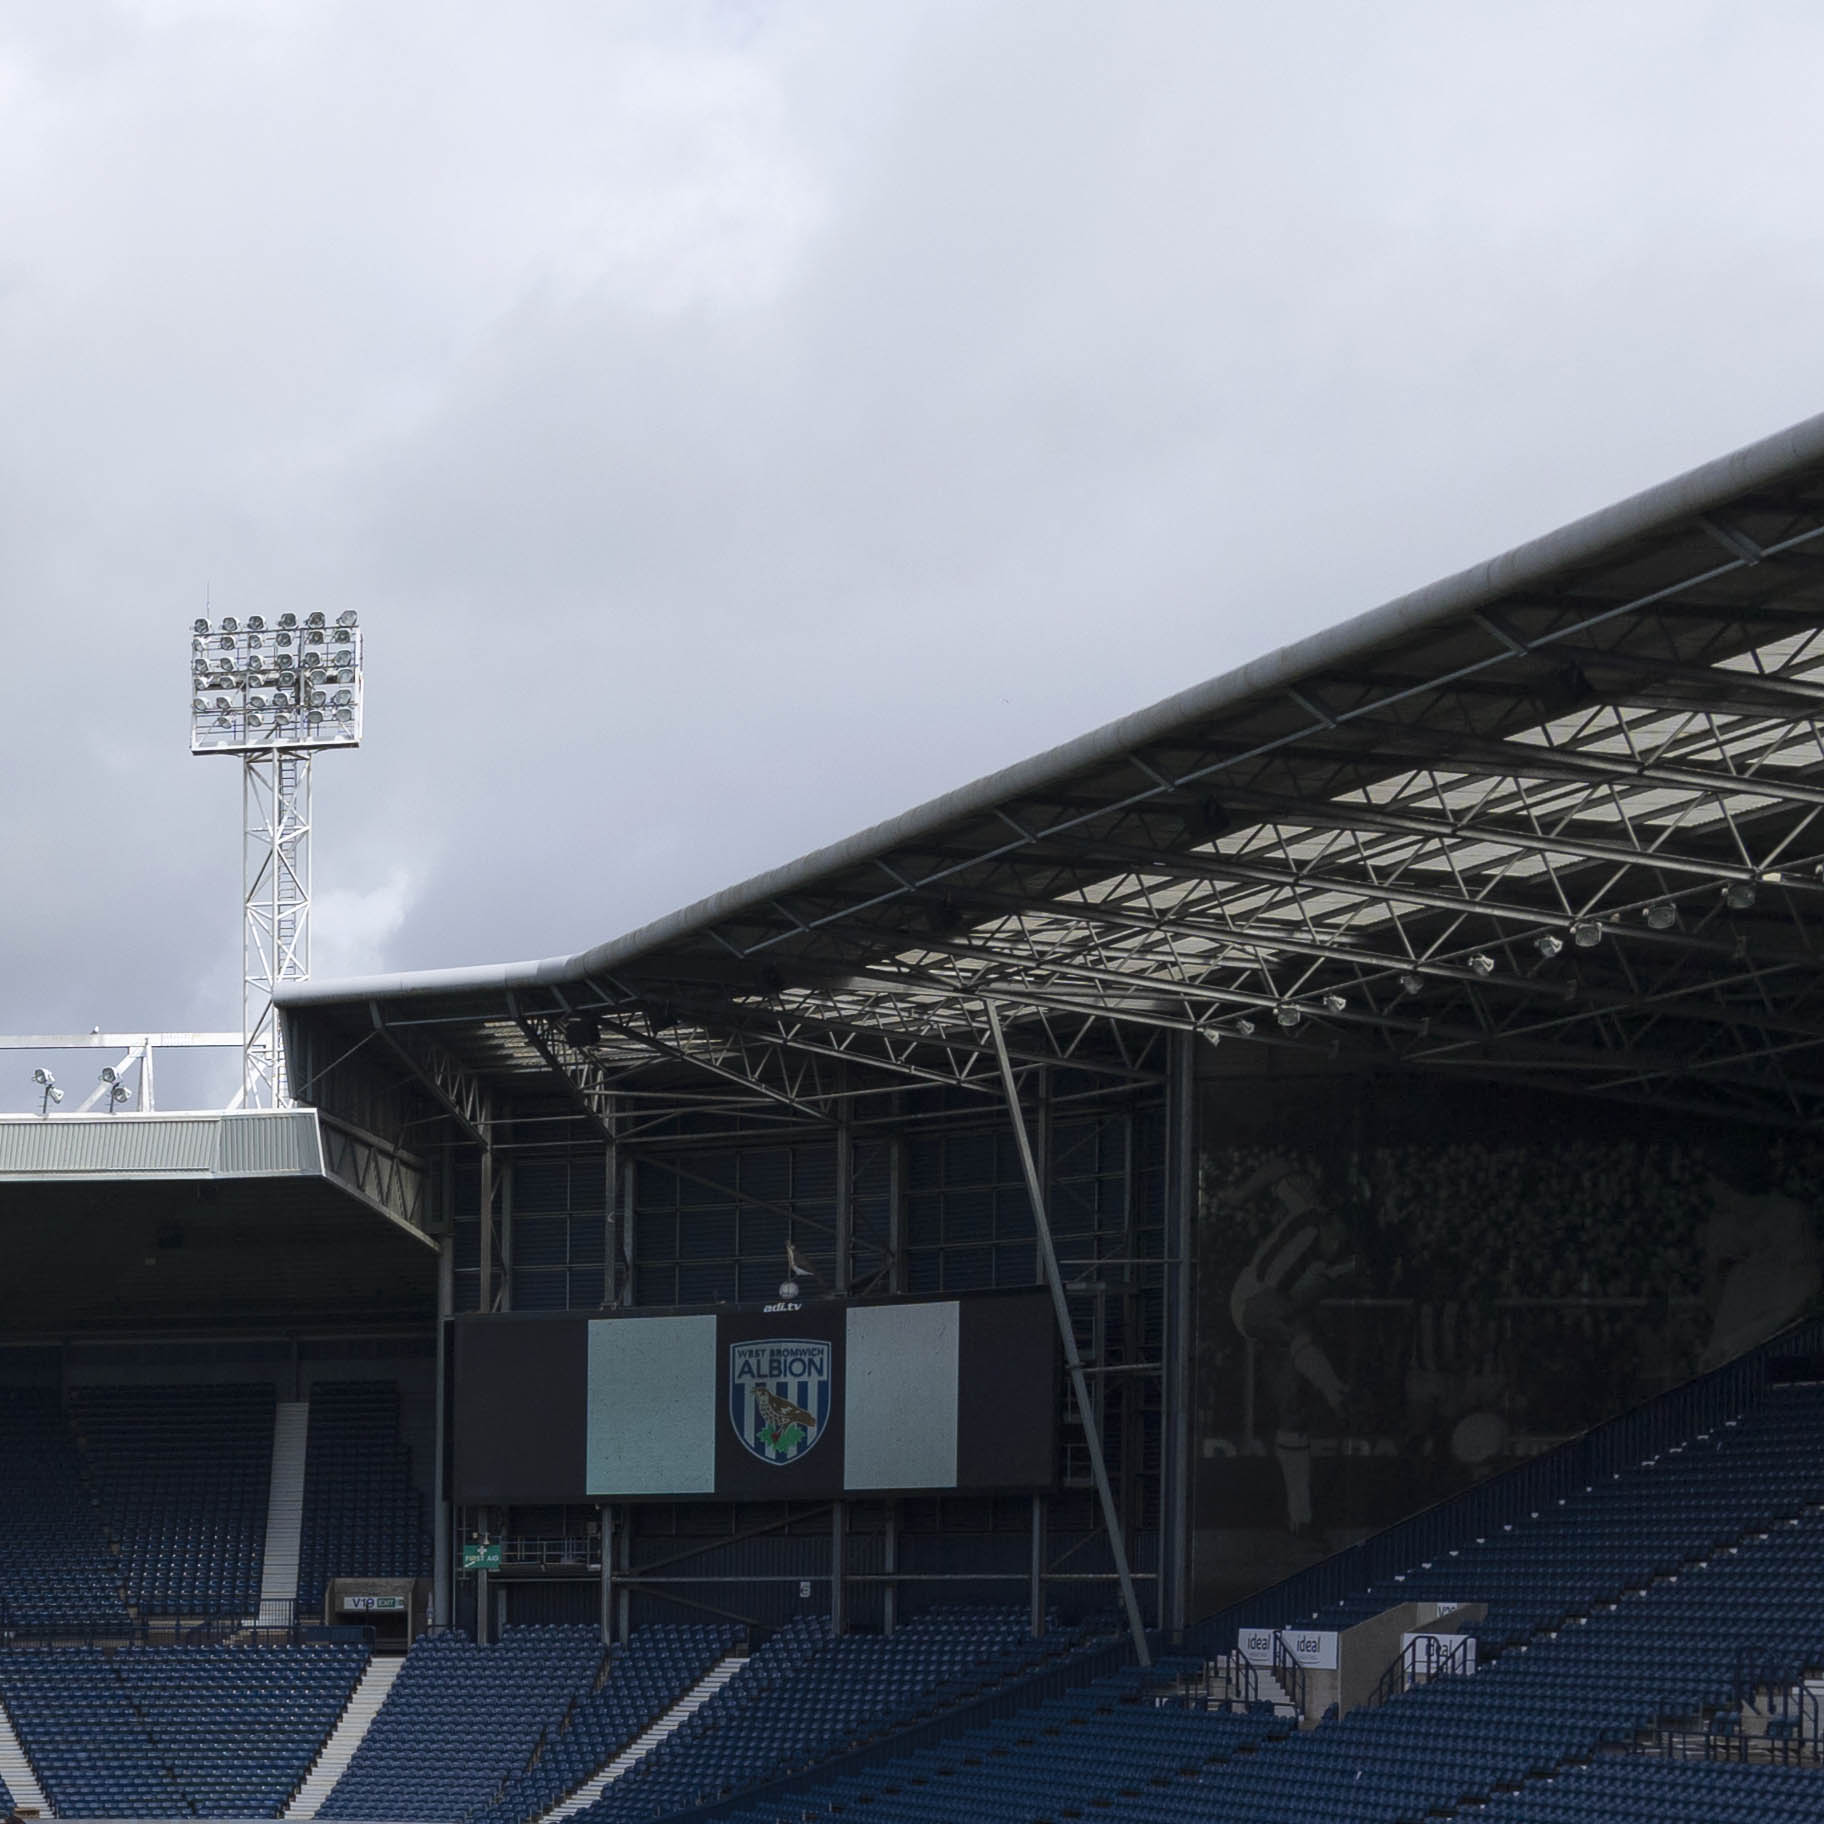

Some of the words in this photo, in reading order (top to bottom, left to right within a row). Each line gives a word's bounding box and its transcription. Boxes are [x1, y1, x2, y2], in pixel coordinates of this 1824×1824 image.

[763, 1302, 802, 1313] adi.tv
[737, 1349, 766, 1358] WEST
[769, 1347, 824, 1358] BROMWICH
[737, 1357, 824, 1379] ALBION
[465, 1554, 485, 1562] FIRST
[486, 1554, 499, 1562] AID
[1247, 1634, 1271, 1650] ideal
[1296, 1636, 1321, 1653] ideal
